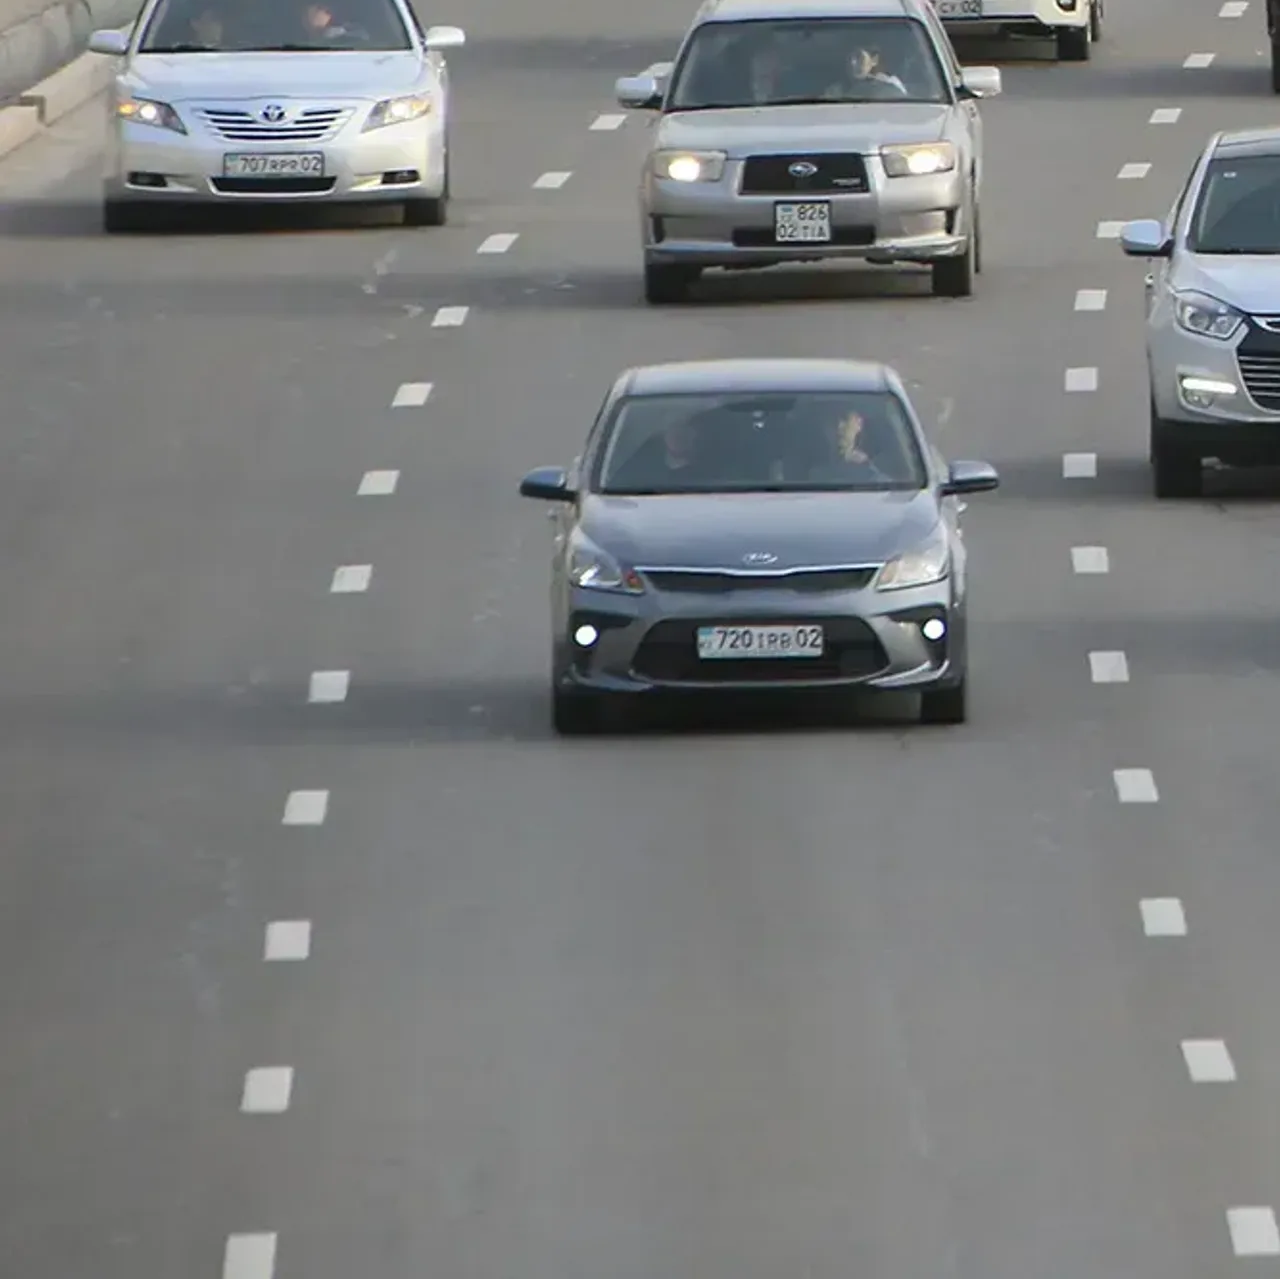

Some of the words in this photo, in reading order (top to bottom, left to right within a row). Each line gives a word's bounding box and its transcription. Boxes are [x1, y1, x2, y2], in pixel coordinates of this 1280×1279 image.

[961, 0, 981, 13] 02
[300, 156, 320, 172] 02
[797, 206, 827, 221] 826
[778, 224, 796, 238] 02
[796, 629, 821, 648] 02
